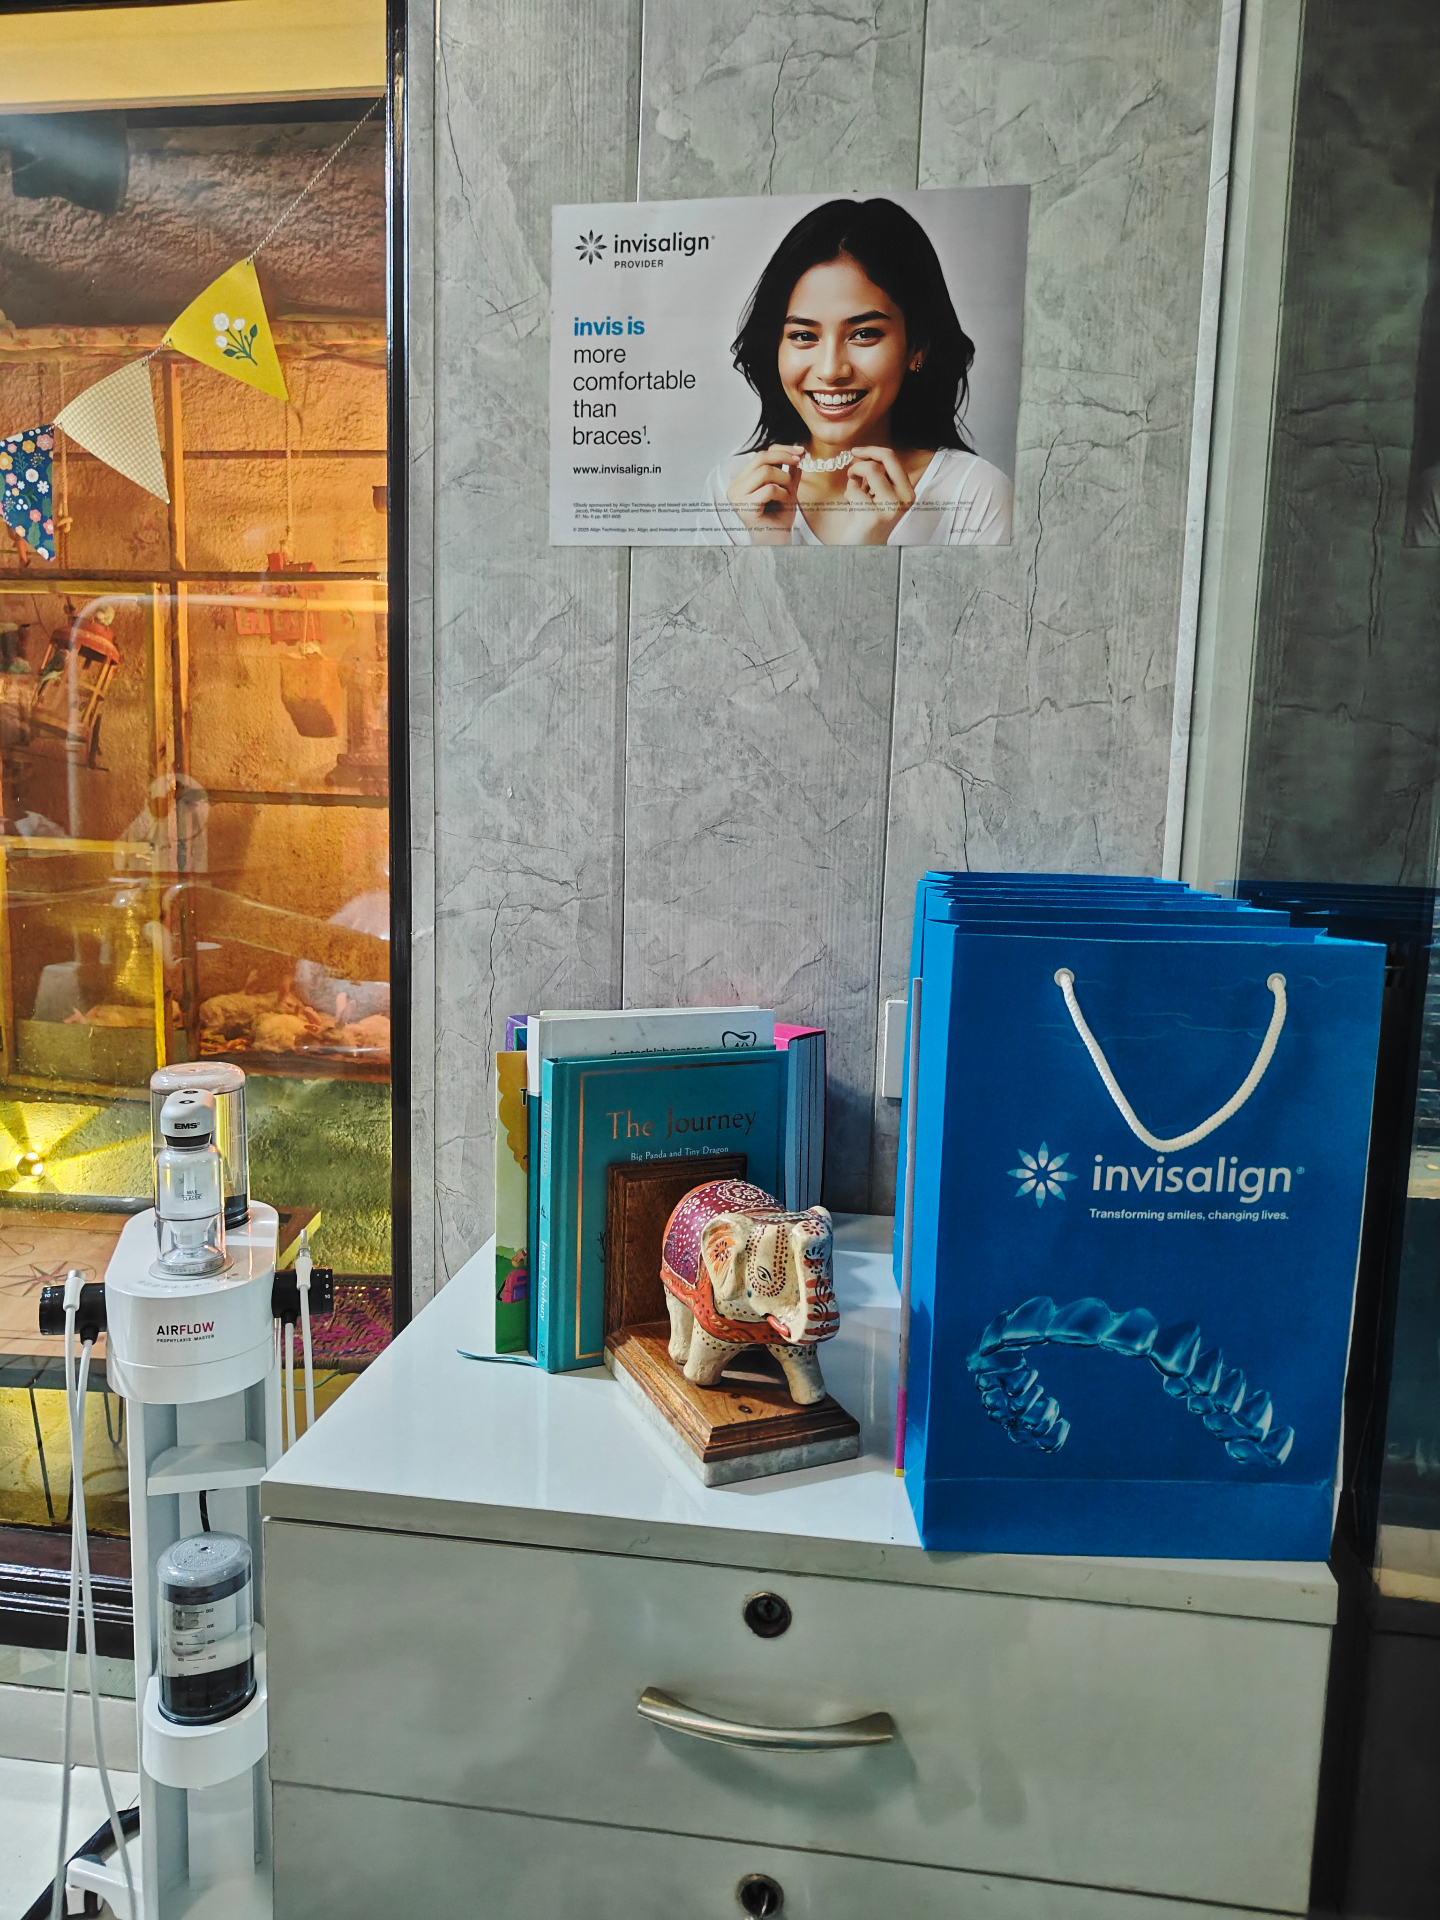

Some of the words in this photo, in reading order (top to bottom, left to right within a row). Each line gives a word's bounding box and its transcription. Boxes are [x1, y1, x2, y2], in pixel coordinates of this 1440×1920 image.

[614, 260, 664, 269] PROVIDER
[574, 316, 624, 336] invis
[627, 316, 645, 336] is
[574, 348, 626, 363] more
[573, 370, 696, 391] comfortable
[573, 400, 617, 418] than
[573, 465, 662, 475] www.invisalign.in
[606, 1109, 654, 1140] The
[666, 1106, 756, 1140] Journey
[630, 1152, 643, 1161] Big
[645, 1151, 667, 1160] Panda
[669, 1148, 682, 1157] and
[684, 1147, 701, 1157] Tiny
[702, 1146, 729, 1155] Dragon
[1089, 1208, 1165, 1222] Transforming
[1167, 1210, 1206, 1221] smiles,
[1208, 1210, 1259, 1222] changing
[1261, 1210, 1289, 1220] lives.
[156, 1321, 215, 1335] AIRFLOW
